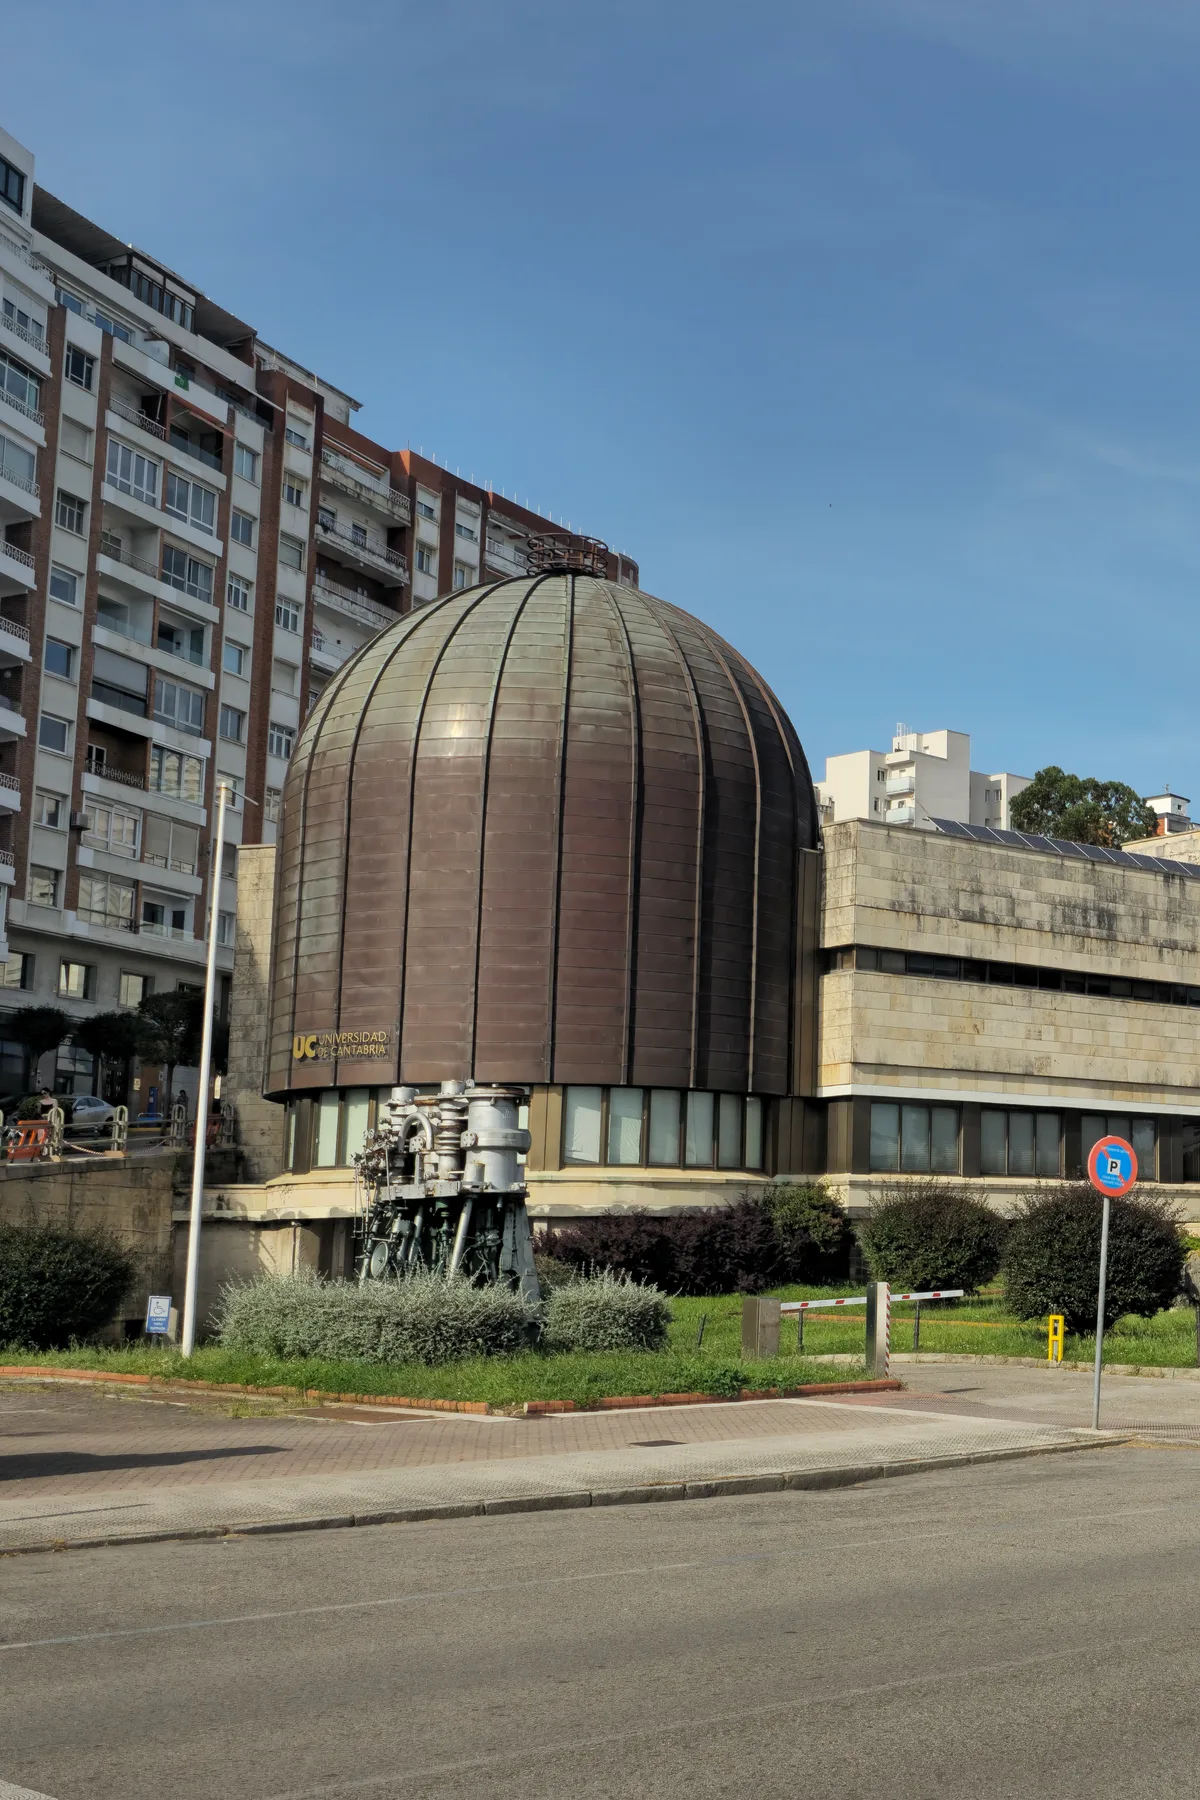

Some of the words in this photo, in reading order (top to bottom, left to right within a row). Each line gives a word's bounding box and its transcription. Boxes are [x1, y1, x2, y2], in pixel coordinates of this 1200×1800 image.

[319, 1031, 387, 1044] UNIVERSIDAD
[293, 1035, 316, 1059] UC
[317, 1047, 329, 1057] DE
[331, 1044, 386, 1057] CANTABRIA
[1110, 1161, 1118, 1172] P
